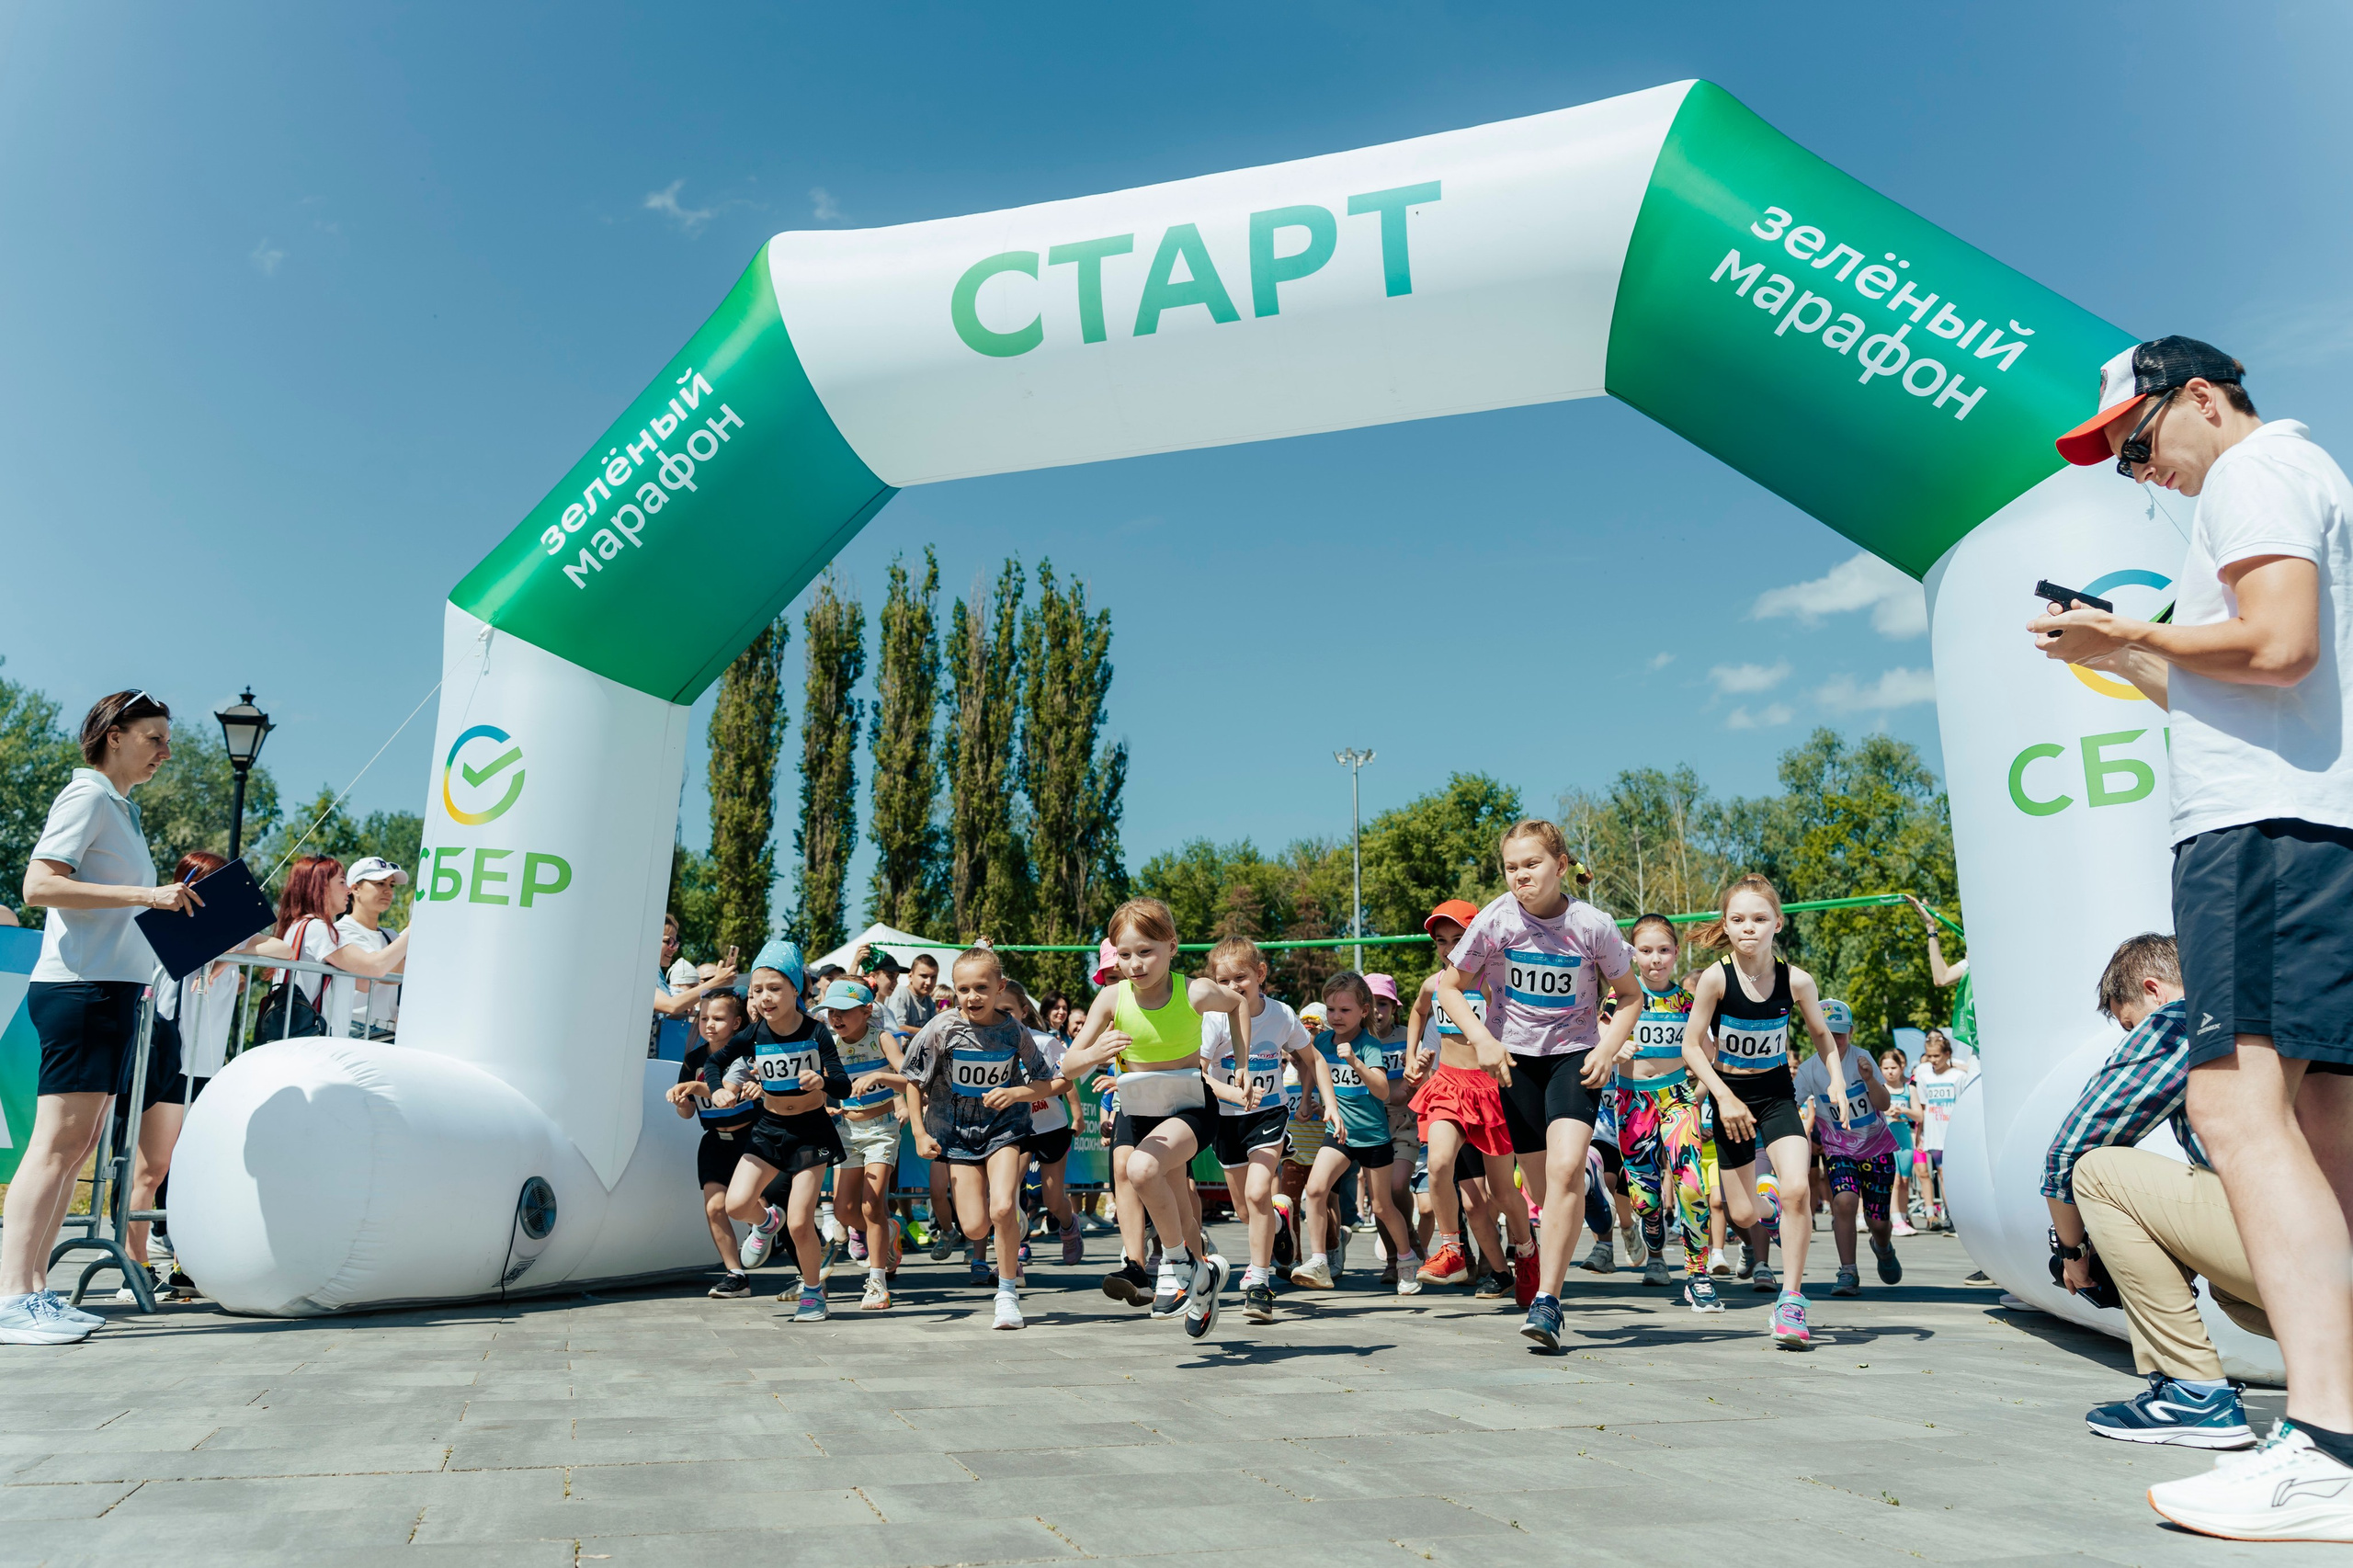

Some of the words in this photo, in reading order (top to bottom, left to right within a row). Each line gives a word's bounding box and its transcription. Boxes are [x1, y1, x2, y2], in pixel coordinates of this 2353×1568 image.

[950, 179, 1441, 358] СТАРТ
[1750, 206, 2036, 372] зелёный
[1709, 248, 1988, 421] марафон
[540, 367, 714, 556] зелёный
[562, 403, 745, 590] марафон
[1510, 967, 1573, 994] 0103
[1437, 1005, 1481, 1024] 06
[1640, 1026, 1685, 1045] 0334
[1725, 1032, 1782, 1057] 0041
[762, 1054, 813, 1079] 0371
[959, 1063, 1009, 1085] 0066
[1331, 1067, 1362, 1085] 345
[1928, 1088, 1950, 1098] 0201
[1031, 1099, 1049, 1114] БОЙ
[1829, 1097, 1869, 1120] 019
